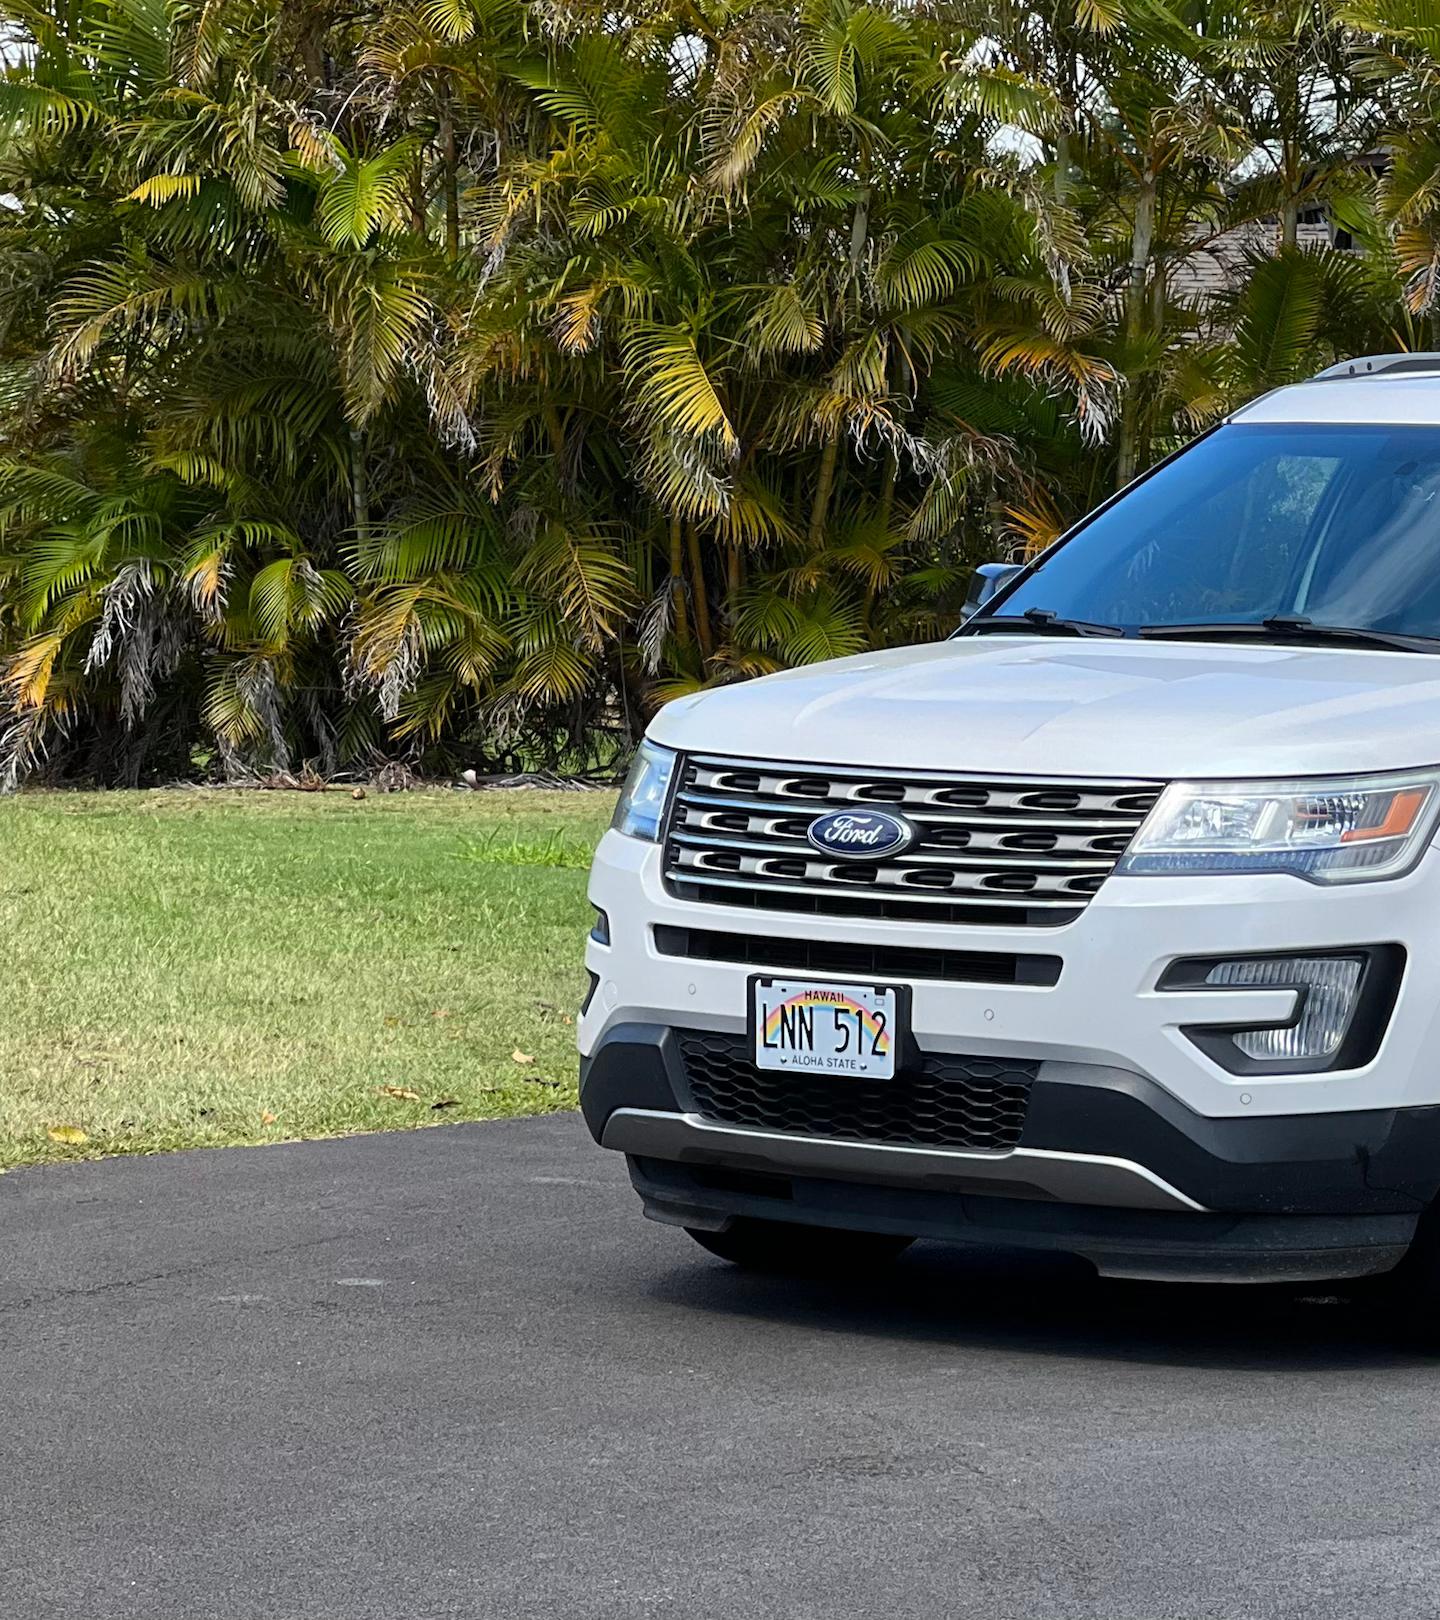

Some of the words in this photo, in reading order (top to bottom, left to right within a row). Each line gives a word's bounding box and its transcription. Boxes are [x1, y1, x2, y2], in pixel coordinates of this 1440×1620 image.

[823, 815, 884, 845] Ford
[804, 990, 844, 1003] HAWAII
[763, 1003, 814, 1051] LNN
[834, 1008, 887, 1057] 512
[792, 1055, 824, 1066] ALOHA
[826, 1058, 857, 1070] STATE
